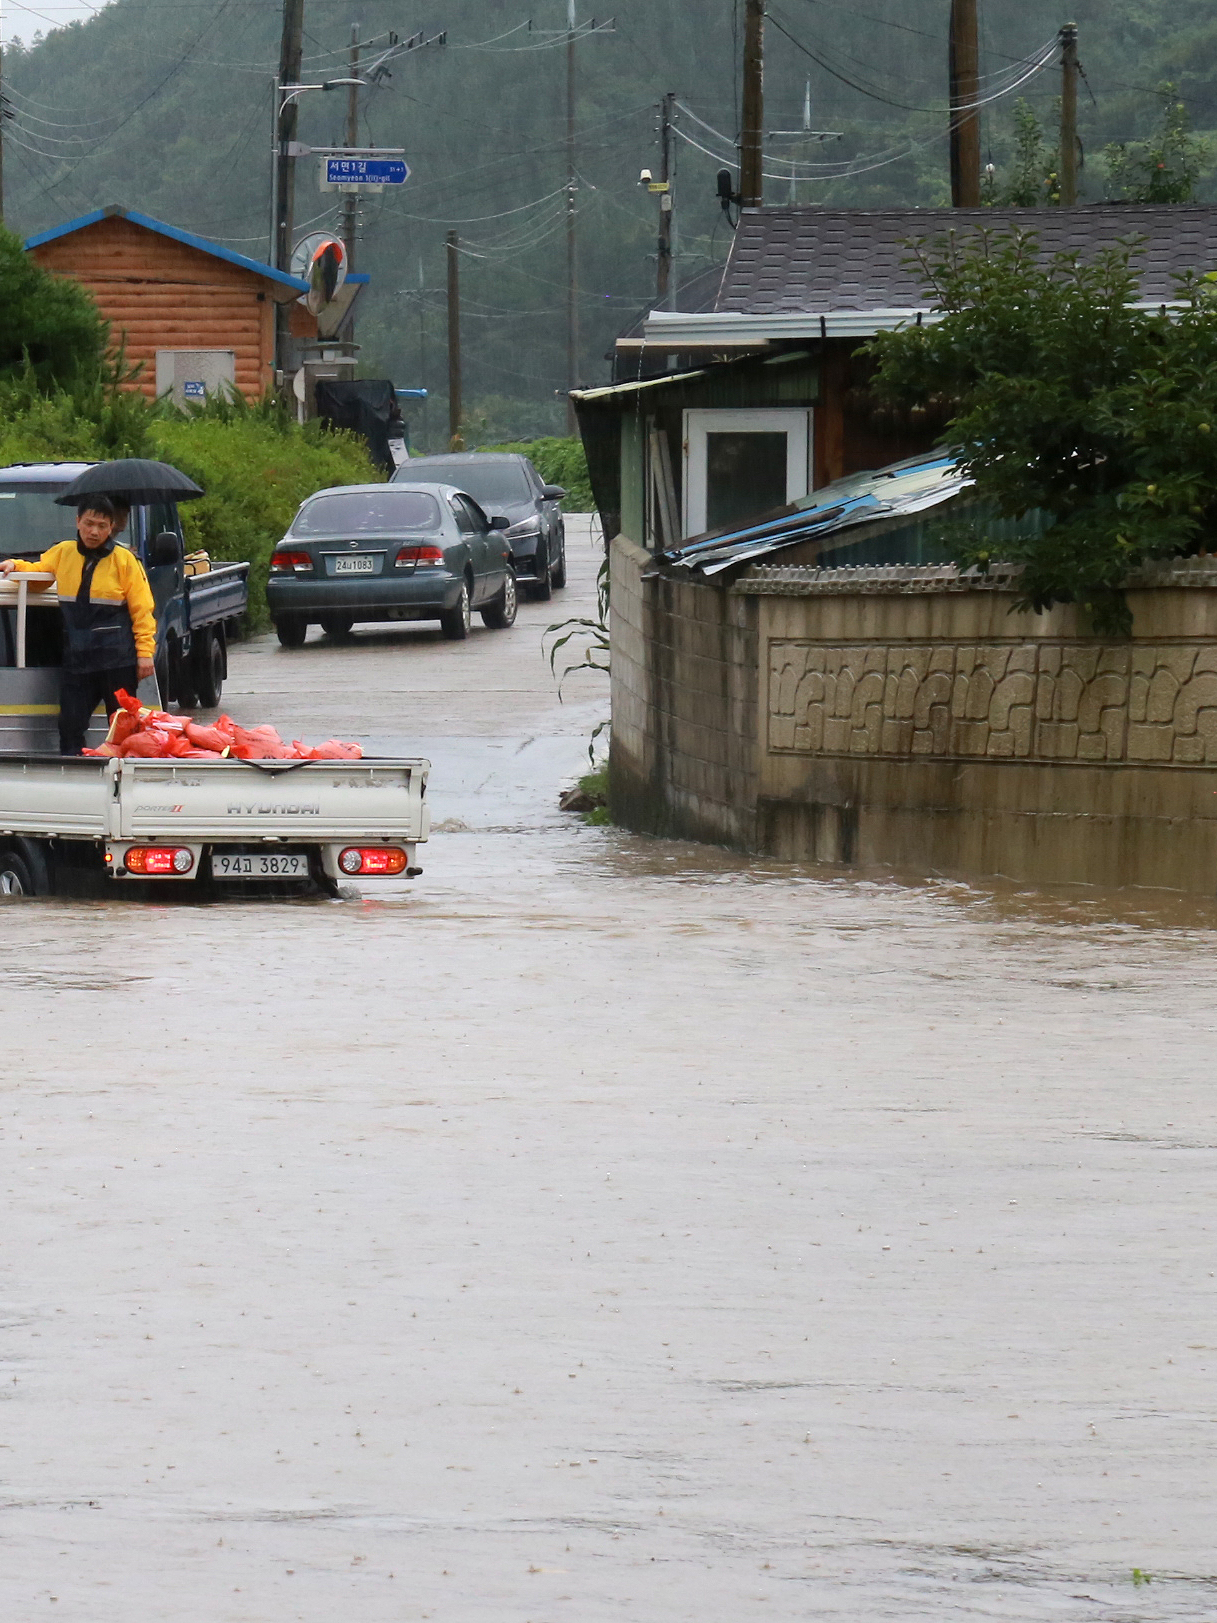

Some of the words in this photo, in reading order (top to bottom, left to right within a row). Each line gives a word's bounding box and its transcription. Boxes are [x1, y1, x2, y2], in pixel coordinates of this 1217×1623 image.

[329, 162, 367, 174] 서면1길
[227, 802, 320, 815] HYUNDAI
[221, 857, 253, 874] 94고
[260, 857, 299, 874] 3829
